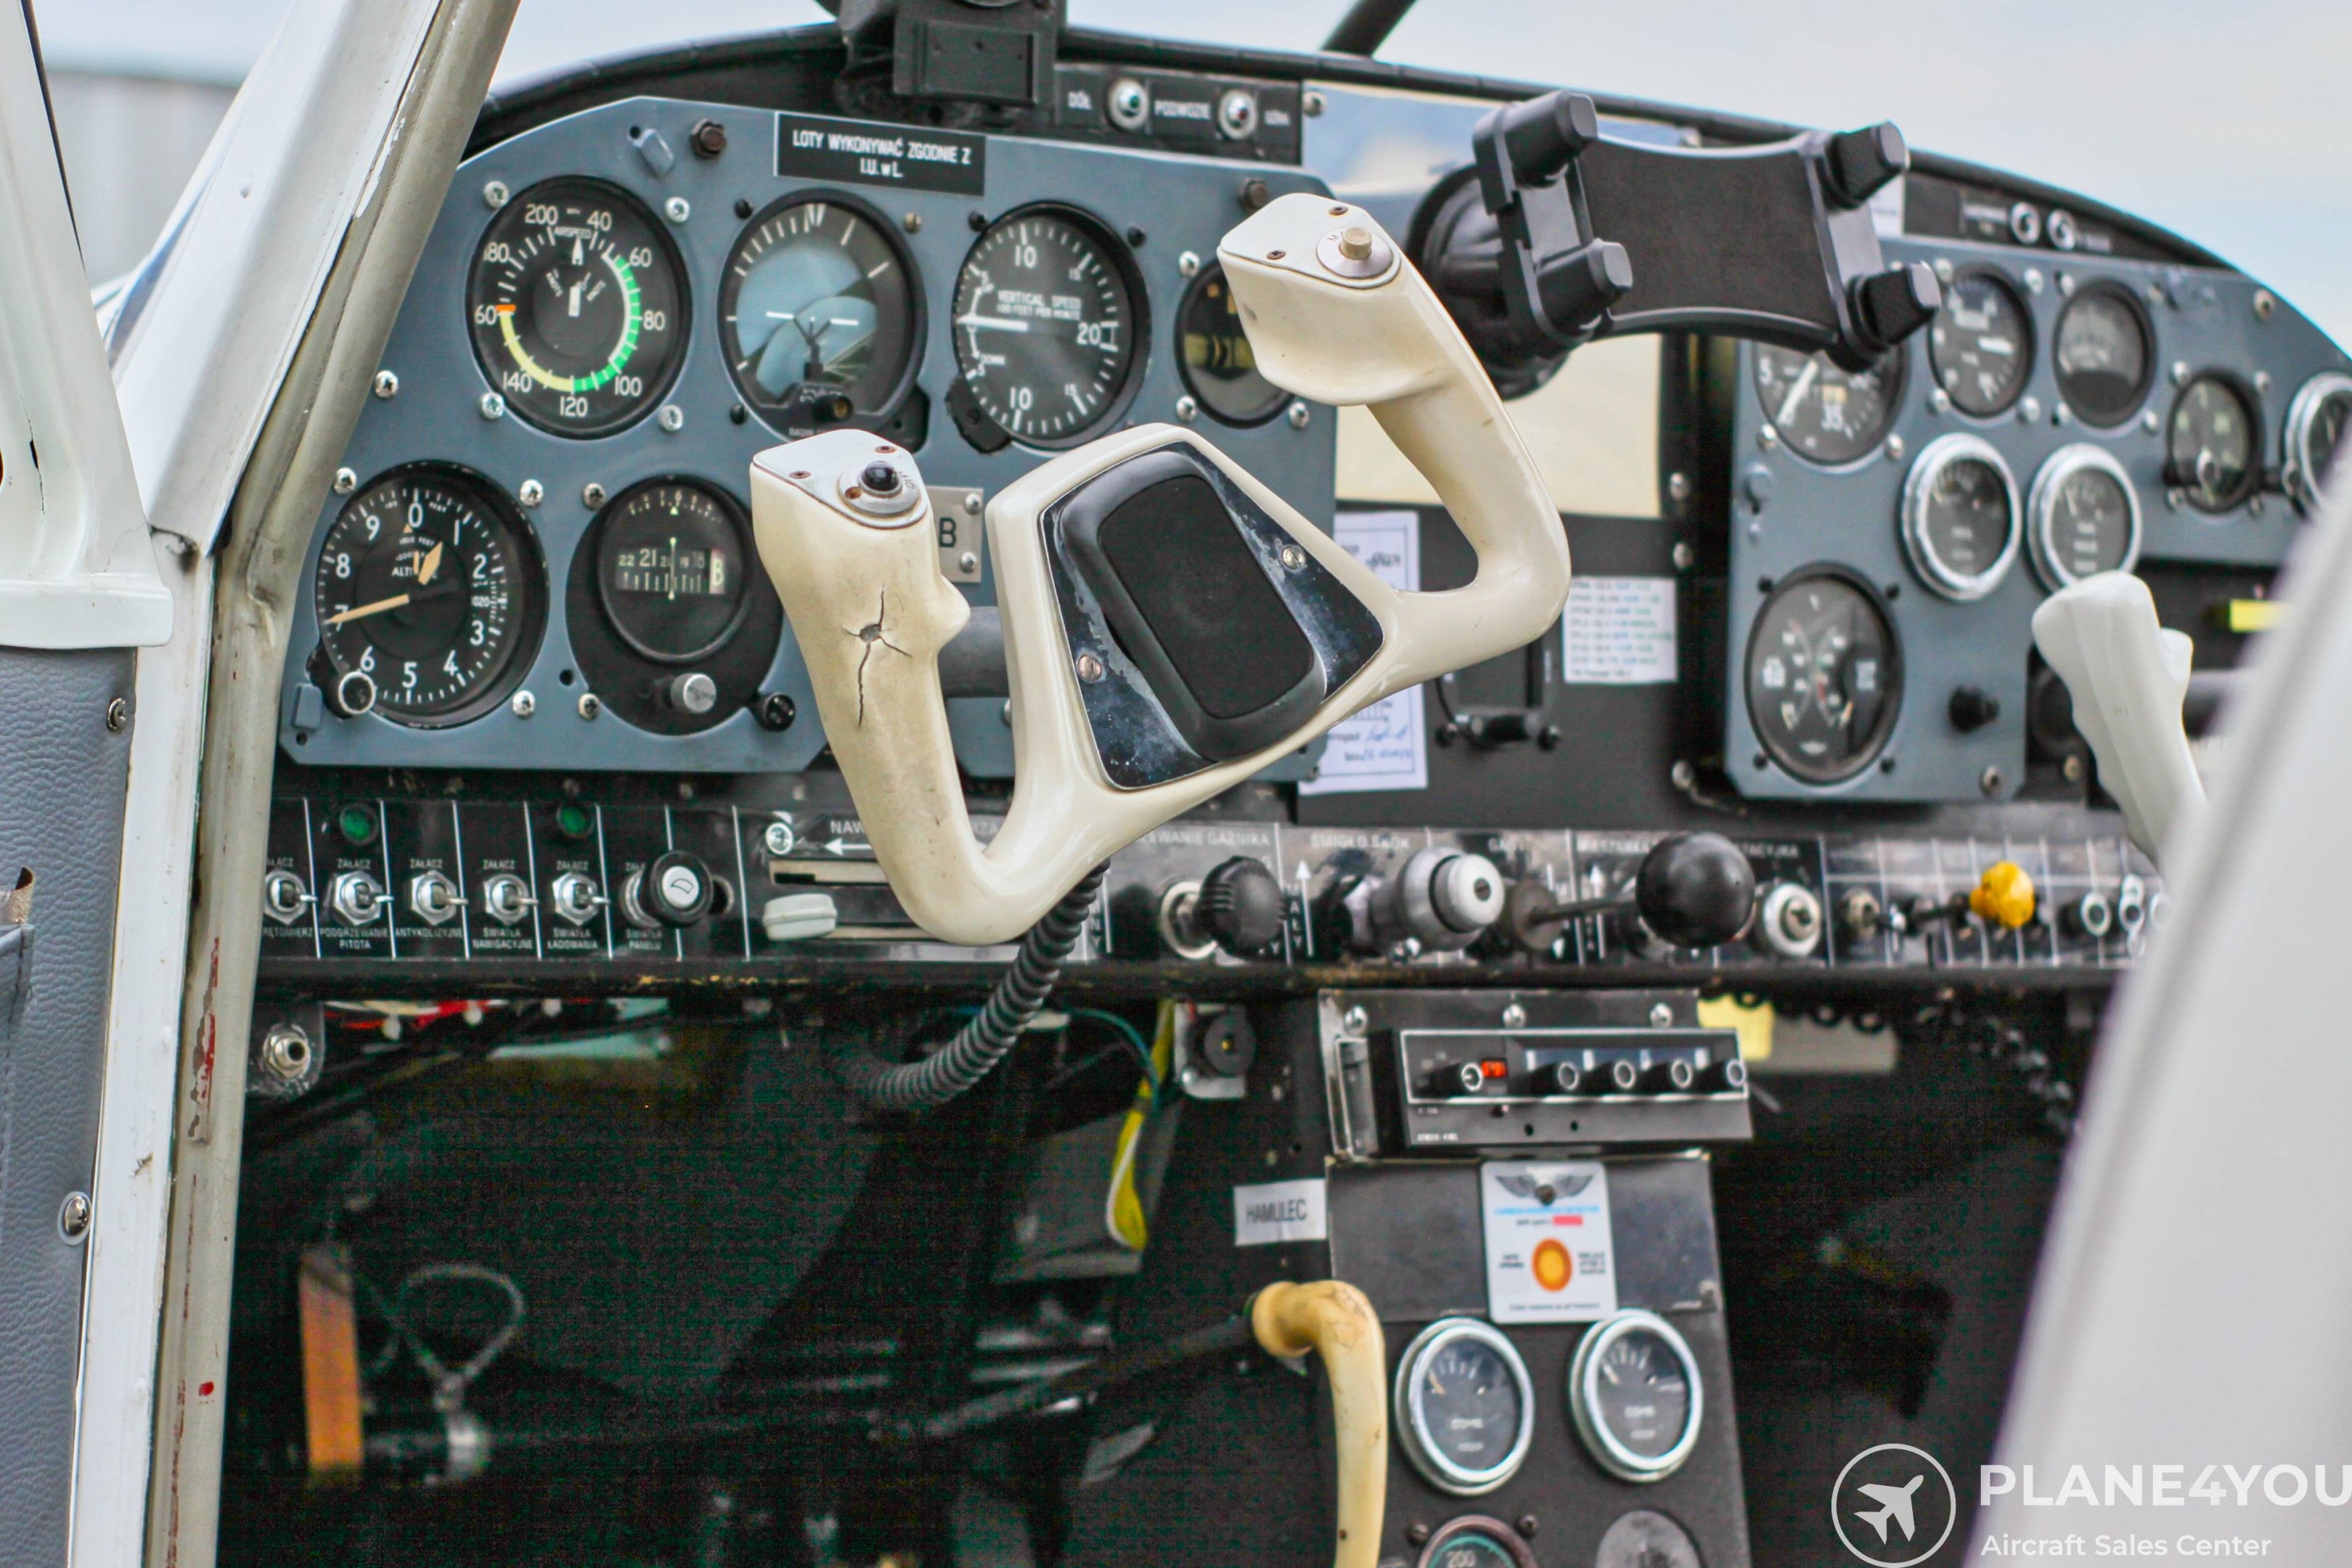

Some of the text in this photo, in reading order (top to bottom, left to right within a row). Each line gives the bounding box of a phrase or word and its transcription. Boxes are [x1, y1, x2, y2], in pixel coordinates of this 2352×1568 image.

[793, 129, 971, 165] LOTY WYKONYWAĆ ZGODNIE Z
[525, 203, 558, 226] 200
[587, 211, 612, 232] 40
[628, 247, 653, 268] 60
[1014, 245, 1037, 269] 10
[1069, 267, 1082, 282] 15
[998, 290, 1082, 310] VERTICAL SPEED
[642, 310, 666, 331] 80
[1077, 322, 1101, 346] 20
[503, 371, 532, 393] 140
[614, 375, 642, 397] 100
[1065, 383, 1077, 396] 15
[560, 396, 589, 417] 120
[1009, 387, 1033, 411] 10
[408, 502, 423, 528] 0
[365, 515, 380, 541] 9
[454, 519, 460, 546] 1
[939, 517, 957, 548] B
[336, 552, 351, 579] 8
[473, 553, 487, 579] 2
[618, 554, 634, 567] 22
[639, 548, 657, 568] 21
[714, 558, 724, 587] B
[470, 620, 485, 646] 3
[361, 645, 375, 672] 6
[443, 650, 459, 675] 4
[401, 661, 418, 688] 5
[830, 820, 865, 835] NAW
[263, 927, 314, 939] RĘTOMIERZ
[320, 927, 388, 939] PODGRZEWANIE
[1246, 1199, 1307, 1224] HAMULEC
